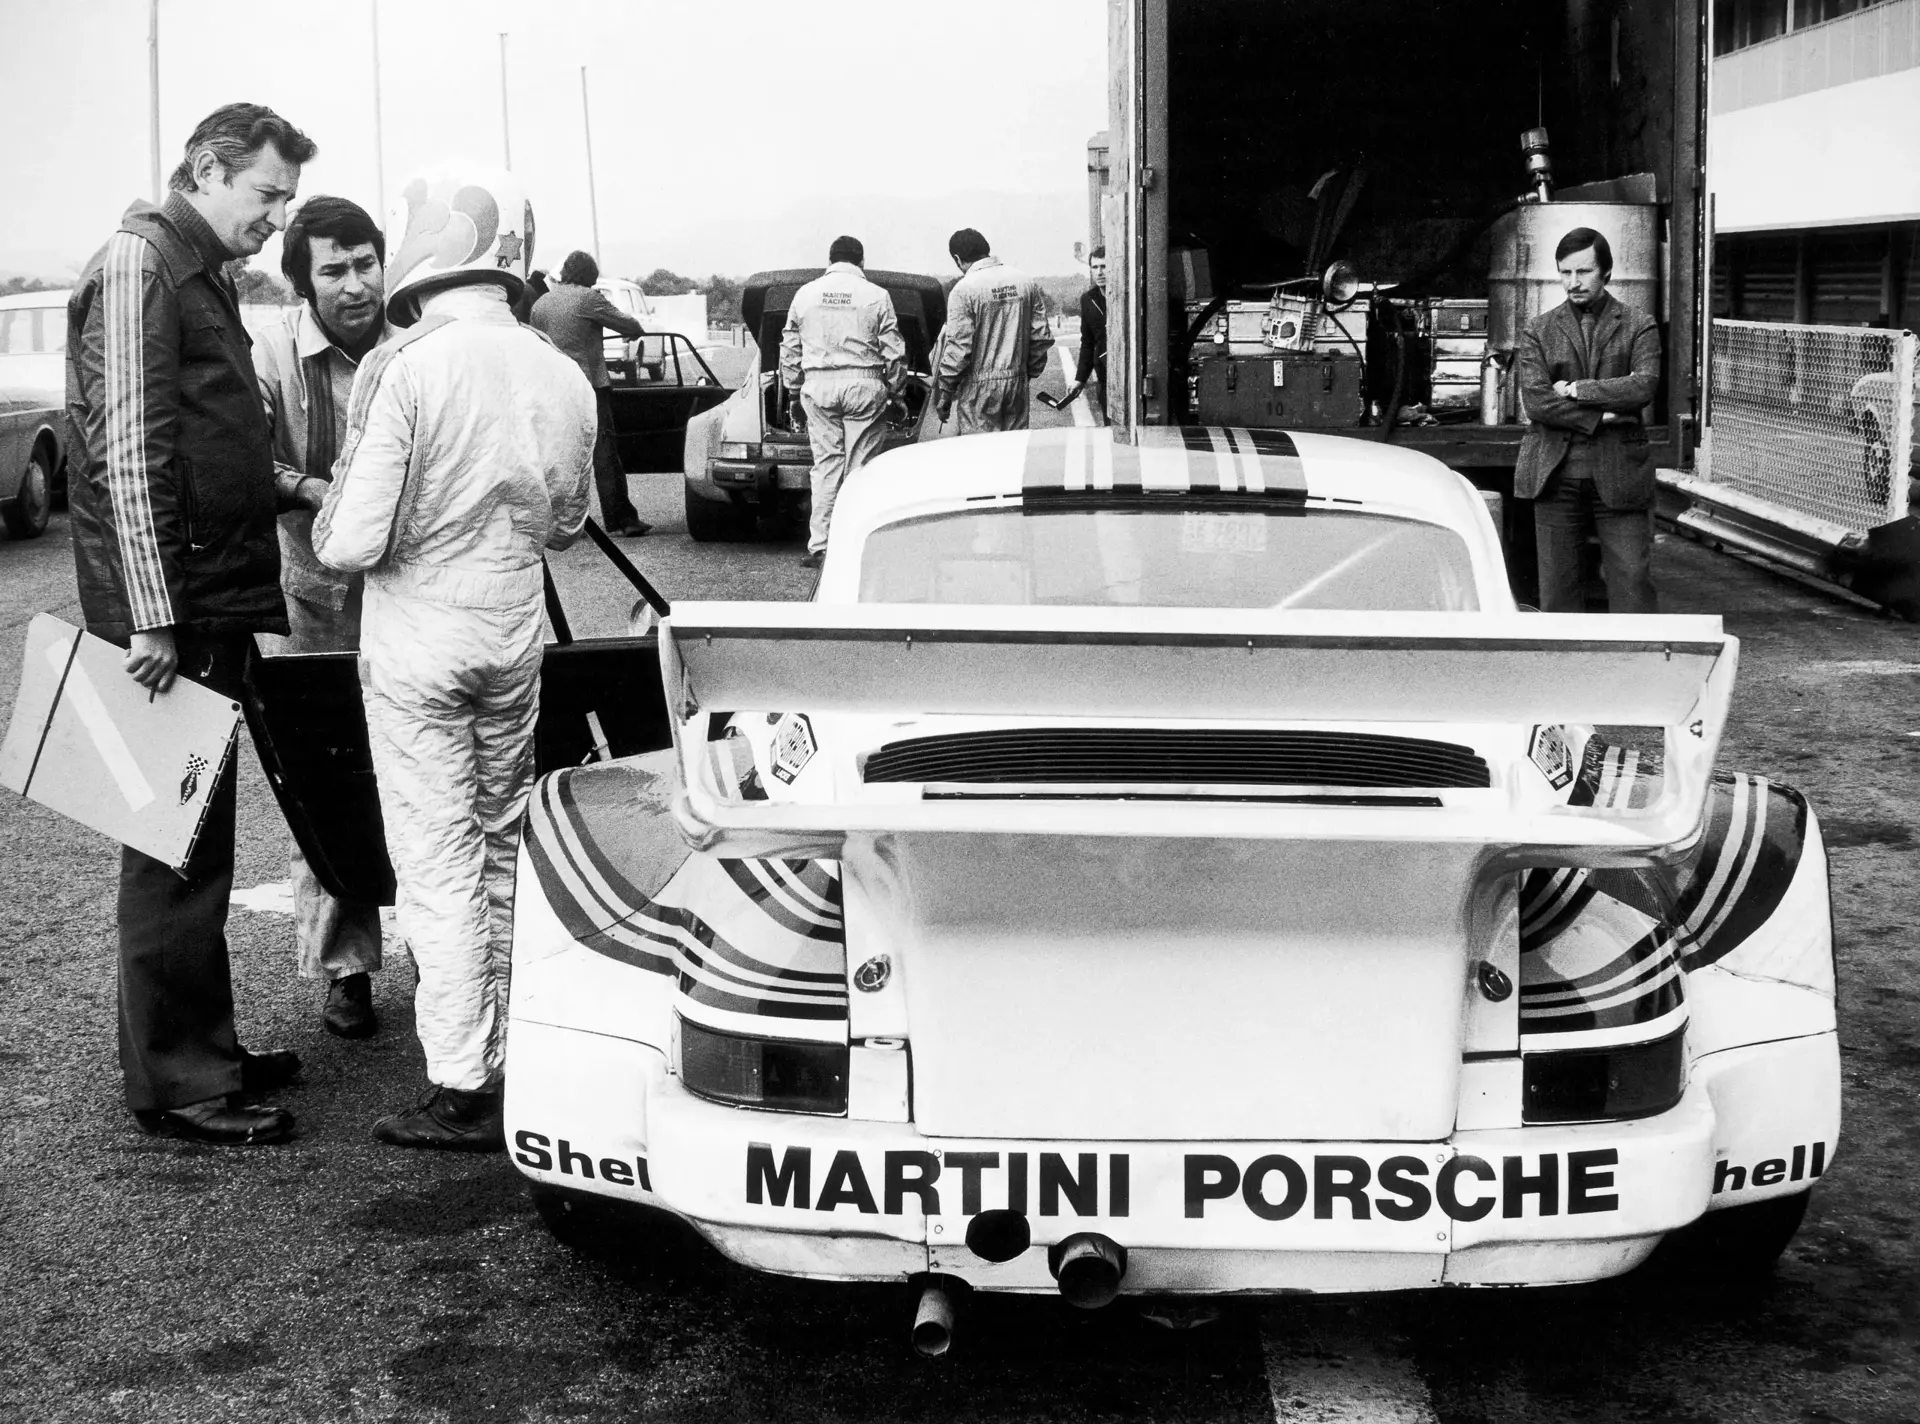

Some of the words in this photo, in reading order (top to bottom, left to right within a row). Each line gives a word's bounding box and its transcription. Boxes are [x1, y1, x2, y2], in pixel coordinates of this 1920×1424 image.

[1267, 402, 1283, 416] 10
[515, 1130, 653, 1193] Shel
[747, 1145, 1130, 1218] MARTINI
[1184, 1148, 1619, 1223] PORSCHE
[1712, 1141, 1825, 1195] hell
